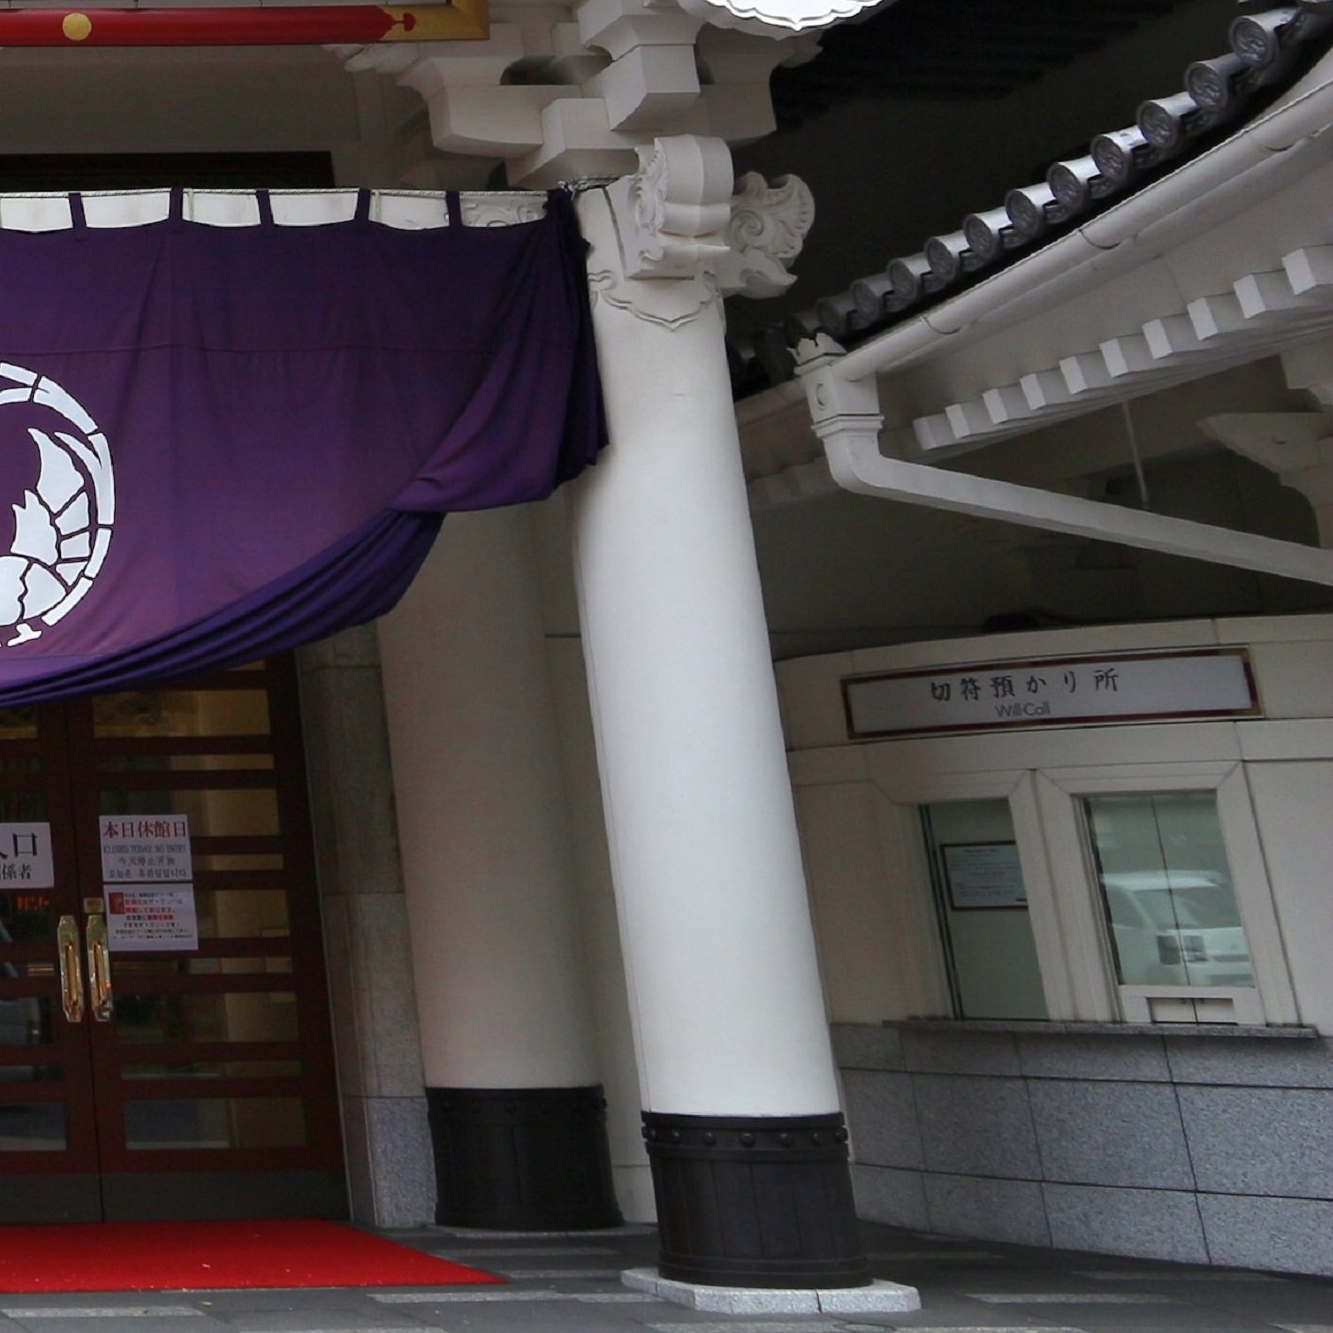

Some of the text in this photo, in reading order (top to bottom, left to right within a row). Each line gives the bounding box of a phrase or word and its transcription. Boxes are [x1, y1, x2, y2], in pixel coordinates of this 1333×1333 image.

[931, 668, 1118, 701] 切符預かり所
[103, 821, 186, 838] 本日休館日
